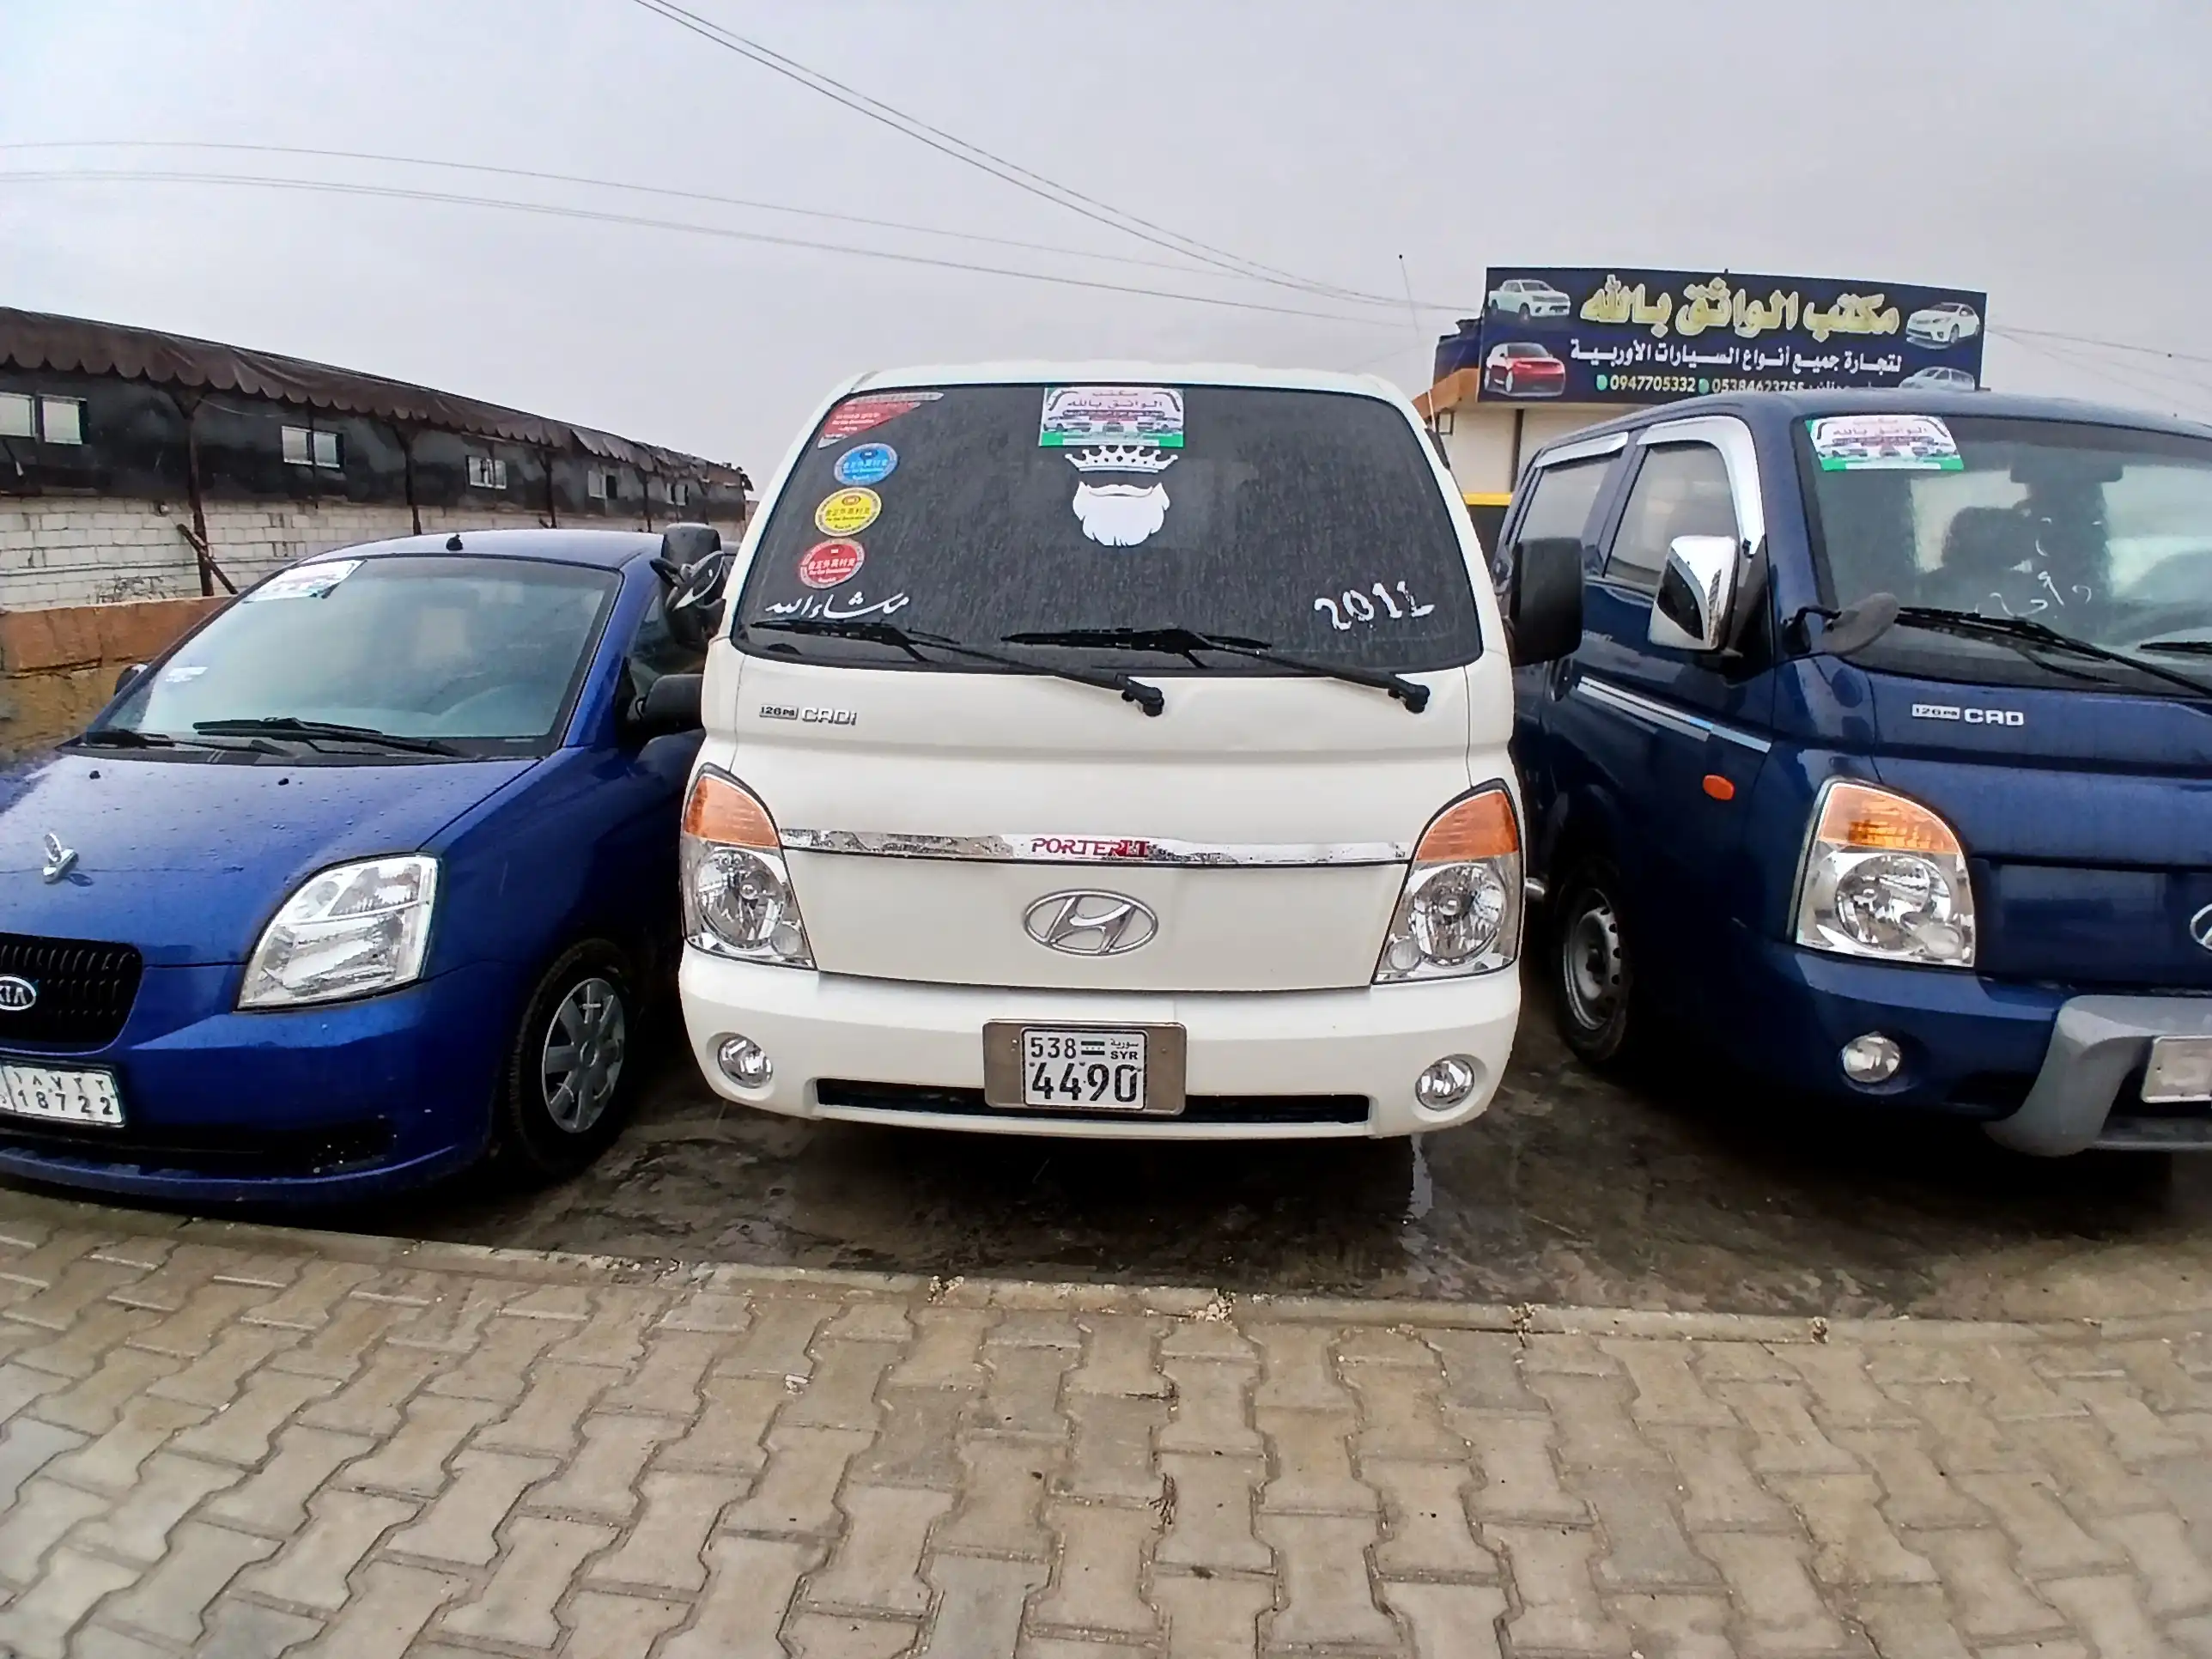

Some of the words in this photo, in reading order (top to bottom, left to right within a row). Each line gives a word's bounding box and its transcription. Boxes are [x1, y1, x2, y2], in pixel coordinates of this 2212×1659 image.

[1580, 274, 1673, 338] بالله
[1675, 276, 1799, 338] الواثق
[1804, 292, 1900, 343] مكتب
[1569, 338, 1652, 367] الأوربية
[1654, 343, 1740, 368] السيارات
[1742, 345, 1790, 371] أنواع
[1791, 353, 1840, 374] جميع
[1844, 350, 1903, 375] لتجارة
[1609, 374, 1696, 392] 0947705332
[1030, 837, 1121, 857] PORTER
[1030, 1037, 1077, 1060] 538
[1109, 1037, 1139, 1050] سورية
[1110, 1050, 1139, 1060] SYR
[1032, 1062, 1138, 1103] 4490
[17, 1089, 114, 1115] 18722
